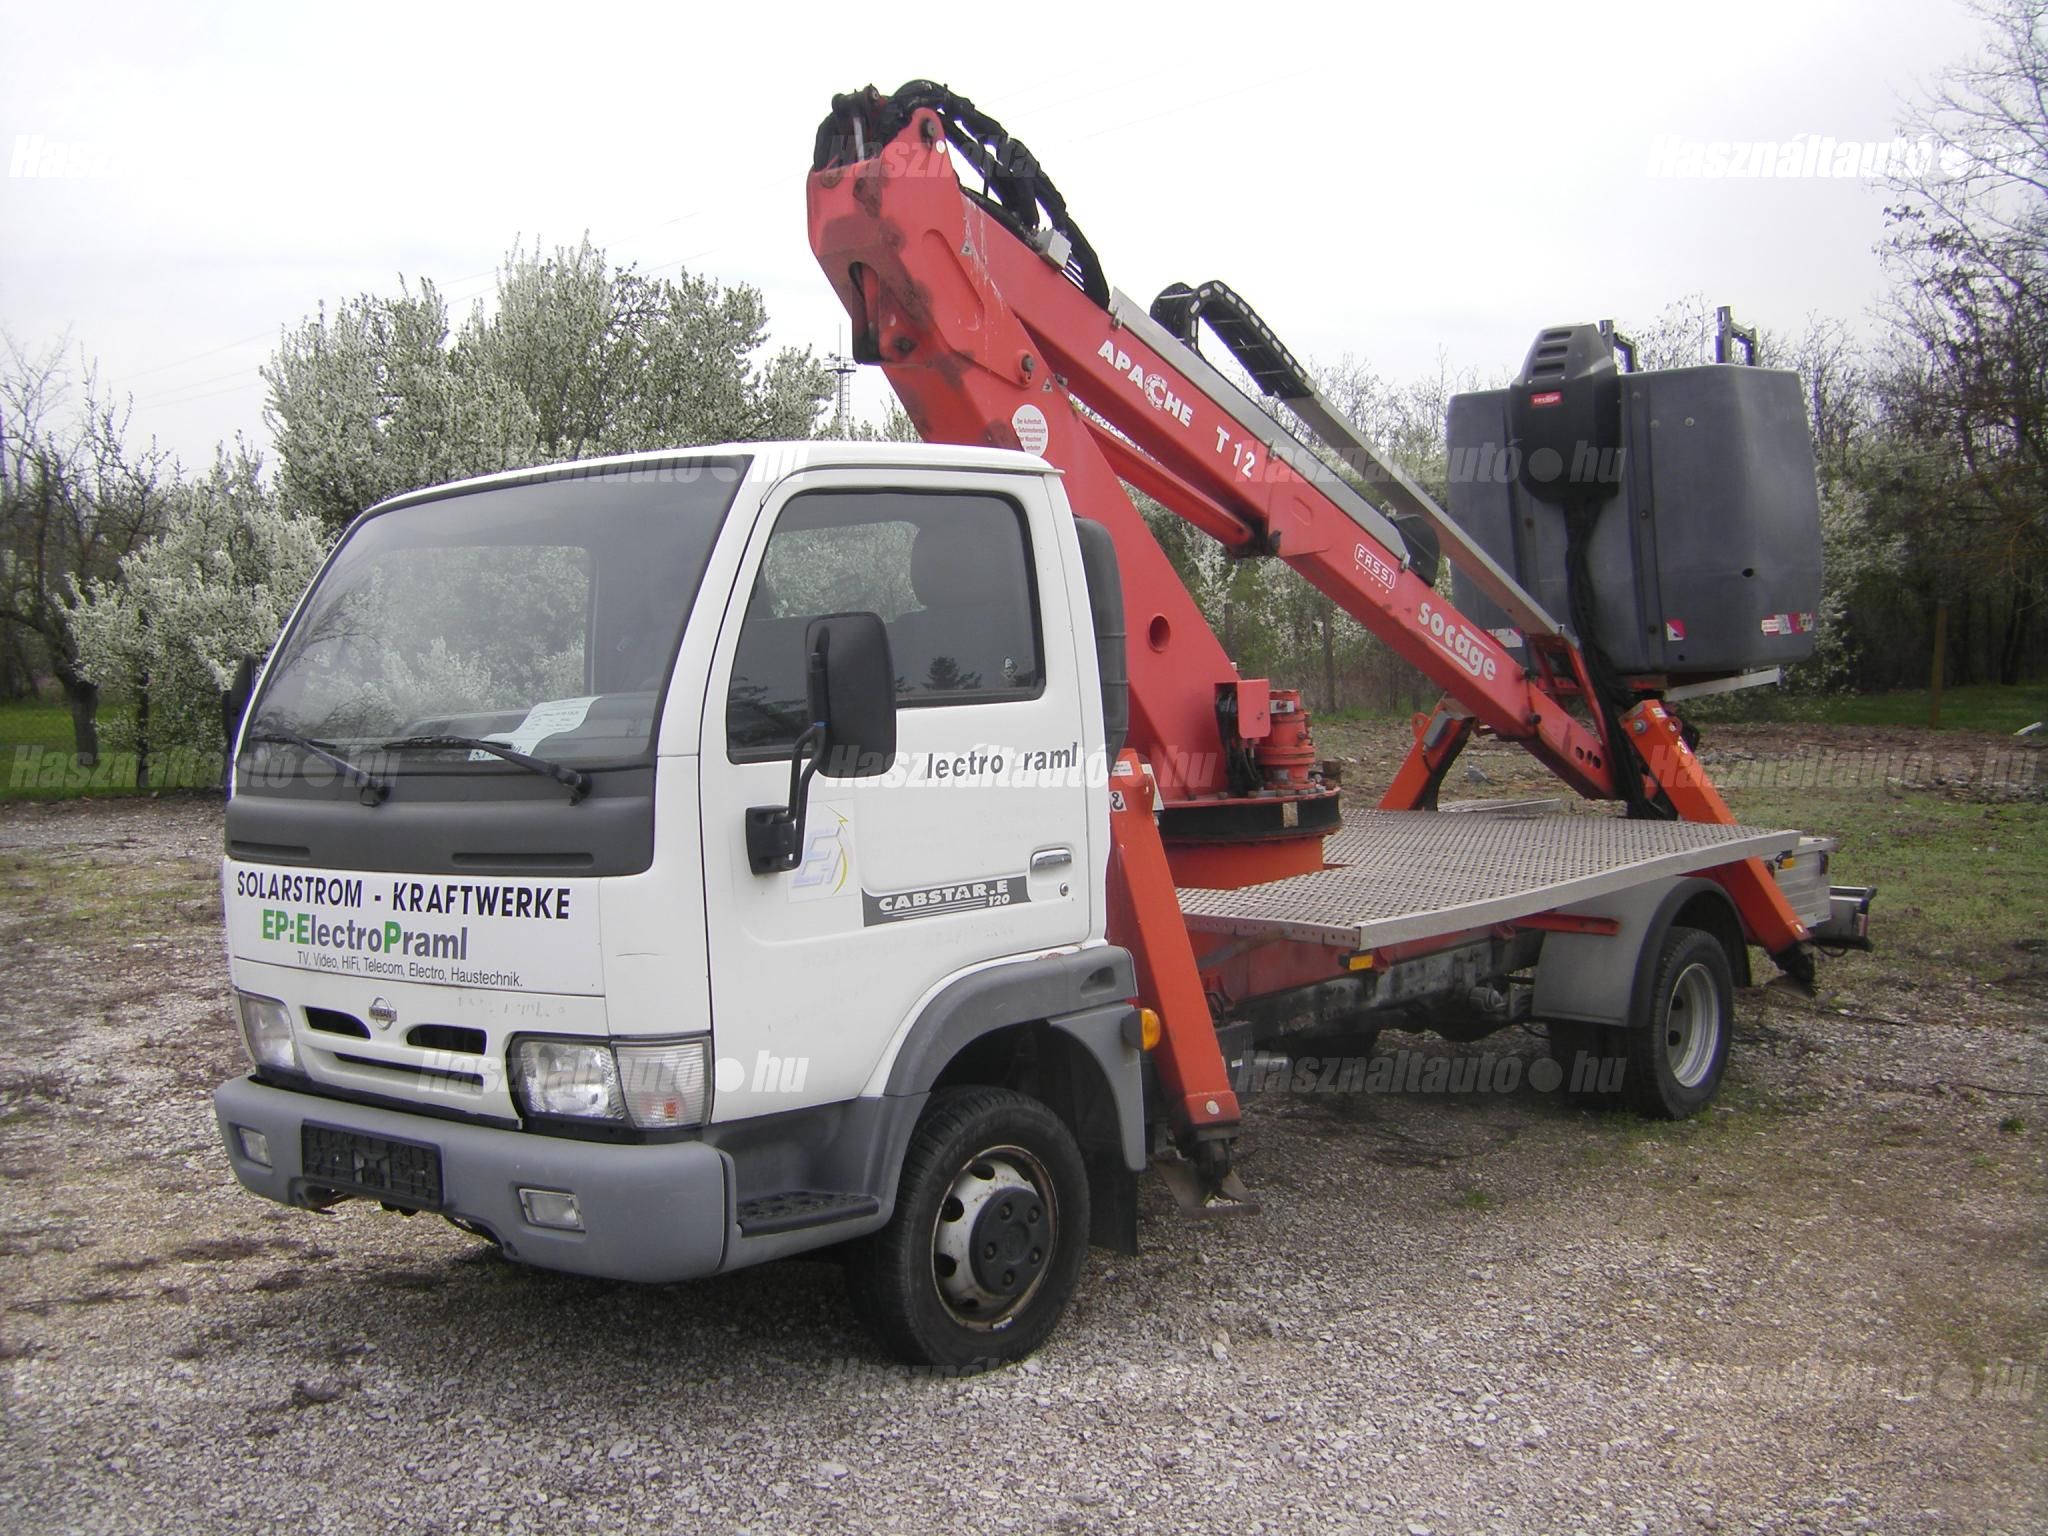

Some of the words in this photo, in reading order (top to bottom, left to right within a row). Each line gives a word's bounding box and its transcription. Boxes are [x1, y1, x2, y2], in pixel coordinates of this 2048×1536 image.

[1097, 340, 1193, 427] APACHE
[1216, 426, 1230, 453] T
[1233, 443, 1255, 478] 12
[1357, 548, 1394, 585] FASSI
[1418, 603, 1496, 680] socage
[927, 751, 1004, 779] lectro
[1023, 742, 1078, 771] raml
[237, 870, 363, 908] SOLARSTROM
[392, 881, 571, 920] KRAFTWERKE
[878, 879, 1009, 911] CABSTAR.E
[988, 894, 1010, 907] 120
[262, 908, 468, 961] EP:ElectroPraml
[408, 962, 447, 982] Electro,
[451, 966, 523, 988] Haustechnik.
